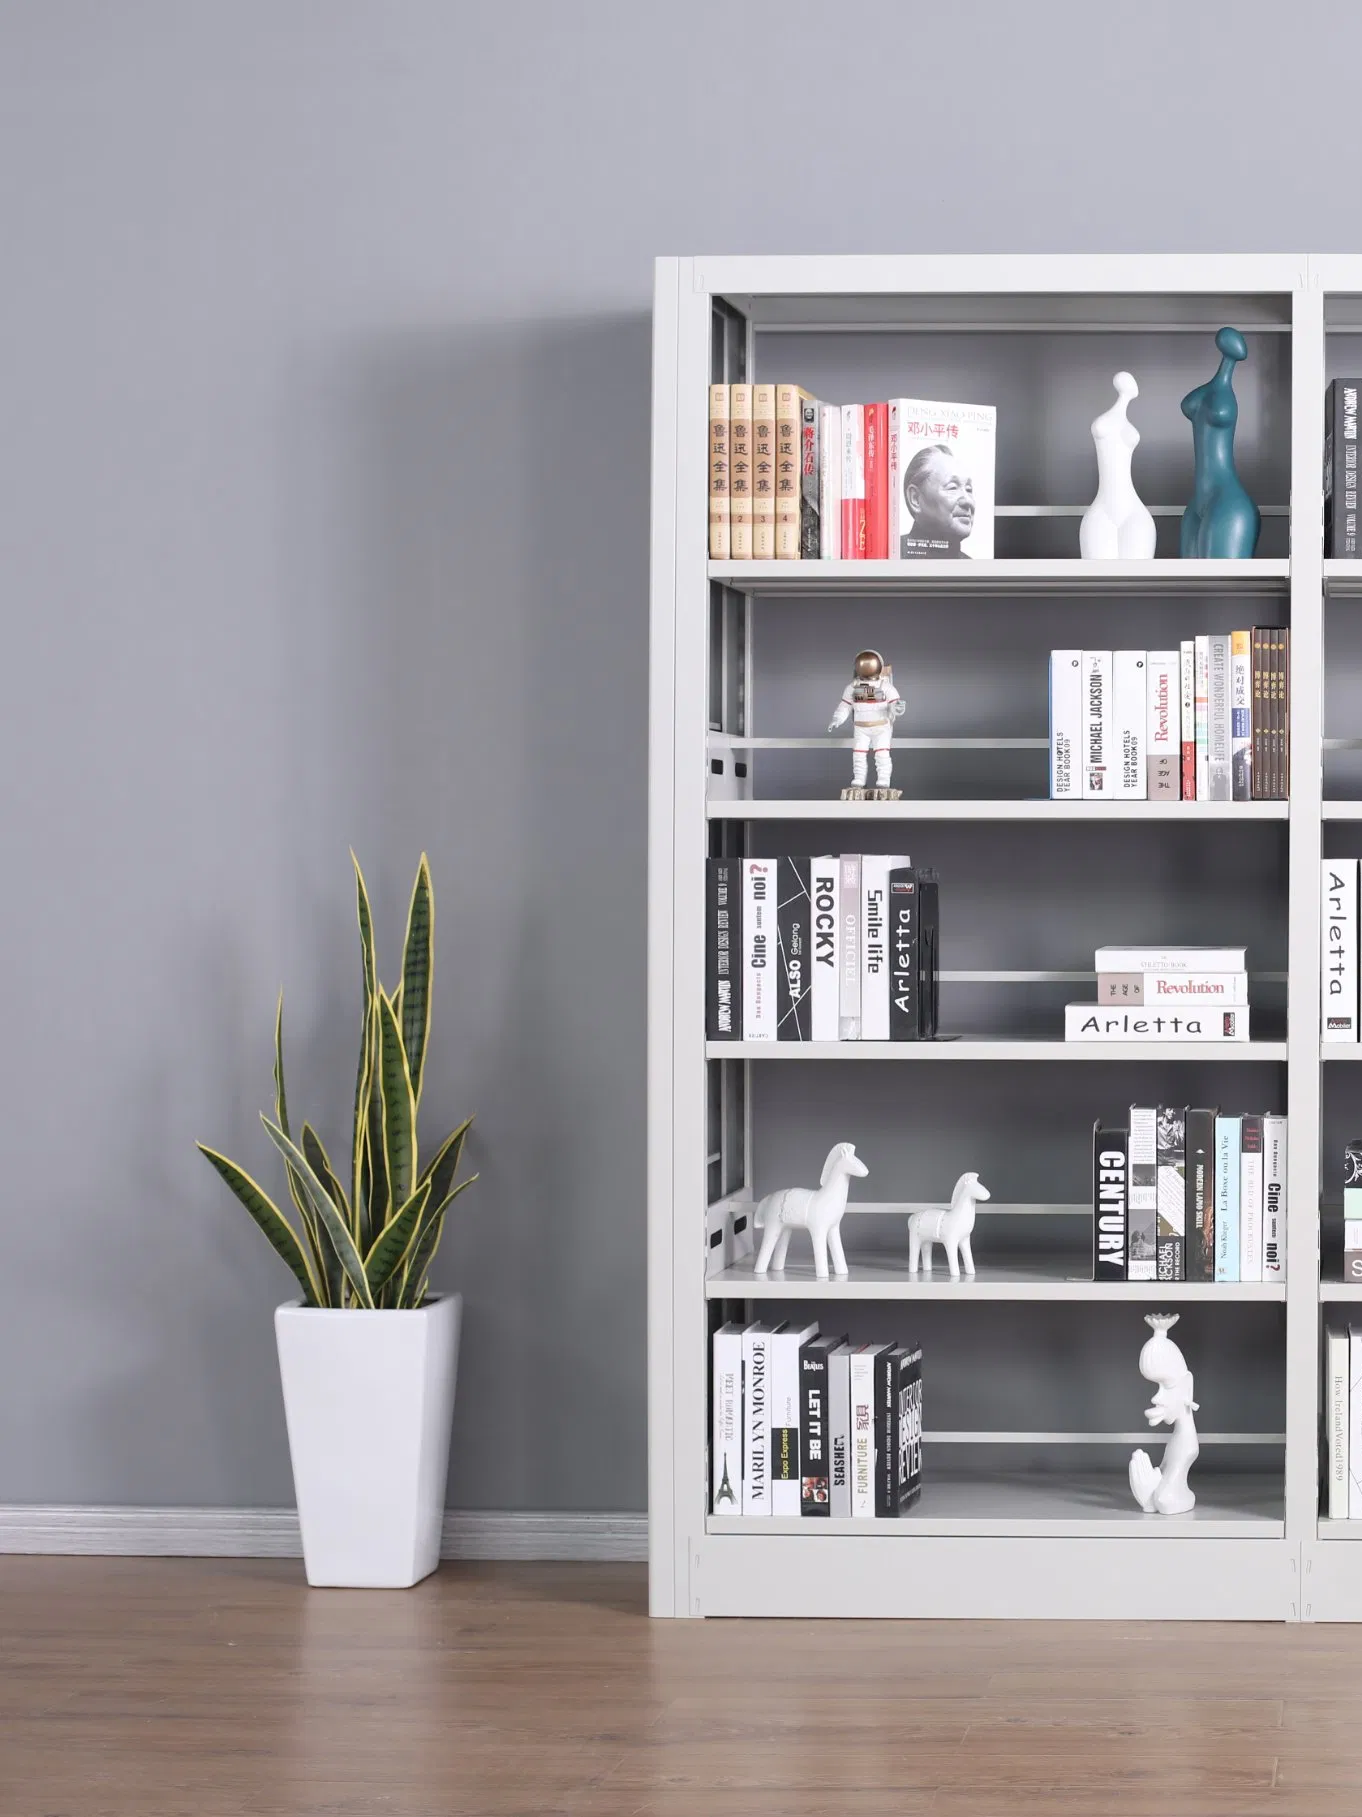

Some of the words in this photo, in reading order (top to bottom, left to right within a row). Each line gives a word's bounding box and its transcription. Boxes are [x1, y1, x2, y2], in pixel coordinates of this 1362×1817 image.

[1343, 387, 1357, 415] ANDREW
[907, 421, 959, 439] 邓小平传
[712, 424, 728, 493] 鲁迅全集
[733, 424, 750, 493] 鲁迅全集
[756, 424, 772, 493] 鲁迅全集
[779, 424, 794, 493] 鲁迅全集
[803, 426, 815, 475] 蒋介石传
[1345, 445, 1357, 469] INTERIOR
[1345, 470, 1357, 489] DESIGN
[1345, 491, 1357, 510] REVIEW
[717, 514, 723, 523] 1
[737, 514, 743, 523] 2
[760, 514, 766, 523] 3
[782, 514, 788, 523] 4
[1214, 643, 1225, 671] CREATE
[1090, 674, 1102, 719] JACKSON
[1155, 673, 1168, 742] Revolution
[1214, 673, 1225, 723] WONDERFUL
[1056, 731, 1064, 761] HOTELS
[1090, 721, 1102, 763] MICHAEL
[1214, 726, 1225, 762] HOMELIFE
[1056, 764, 1064, 792] DESIGN
[718, 910, 729, 929] REVIEW
[815, 877, 835, 968] ROCKY
[867, 890, 883, 938] Smile
[718, 931, 729, 950] DESIGN
[1329, 871, 1347, 996] Arletta
[718, 951, 729, 975] INTERIOR
[751, 934, 767, 969] Cine
[846, 914, 856, 986] OFFICIEL
[867, 943, 883, 974] life
[894, 909, 910, 1013] Arletta
[789, 959, 801, 999] ALSO
[1134, 984, 1140, 993] OF
[1156, 980, 1225, 995] Revolution
[717, 1004, 731, 1033] ANDREW
[1081, 1015, 1202, 1034] Arletta
[1221, 1135, 1229, 1149] Vie
[1098, 1151, 1126, 1267] CENTURY
[1221, 1200, 1228, 1211] La
[1267, 1183, 1281, 1213] Cine
[1265, 1242, 1281, 1272] noi?
[752, 1341, 765, 1418] MONROE
[809, 1389, 821, 1418] LET
[809, 1422, 821, 1435] IT
[781, 1429, 789, 1458] Express
[809, 1439, 821, 1461] BE
[752, 1421, 765, 1500] MARILYN
[781, 1460, 789, 1479] Expo
[858, 1437, 868, 1494] FURNITURE
